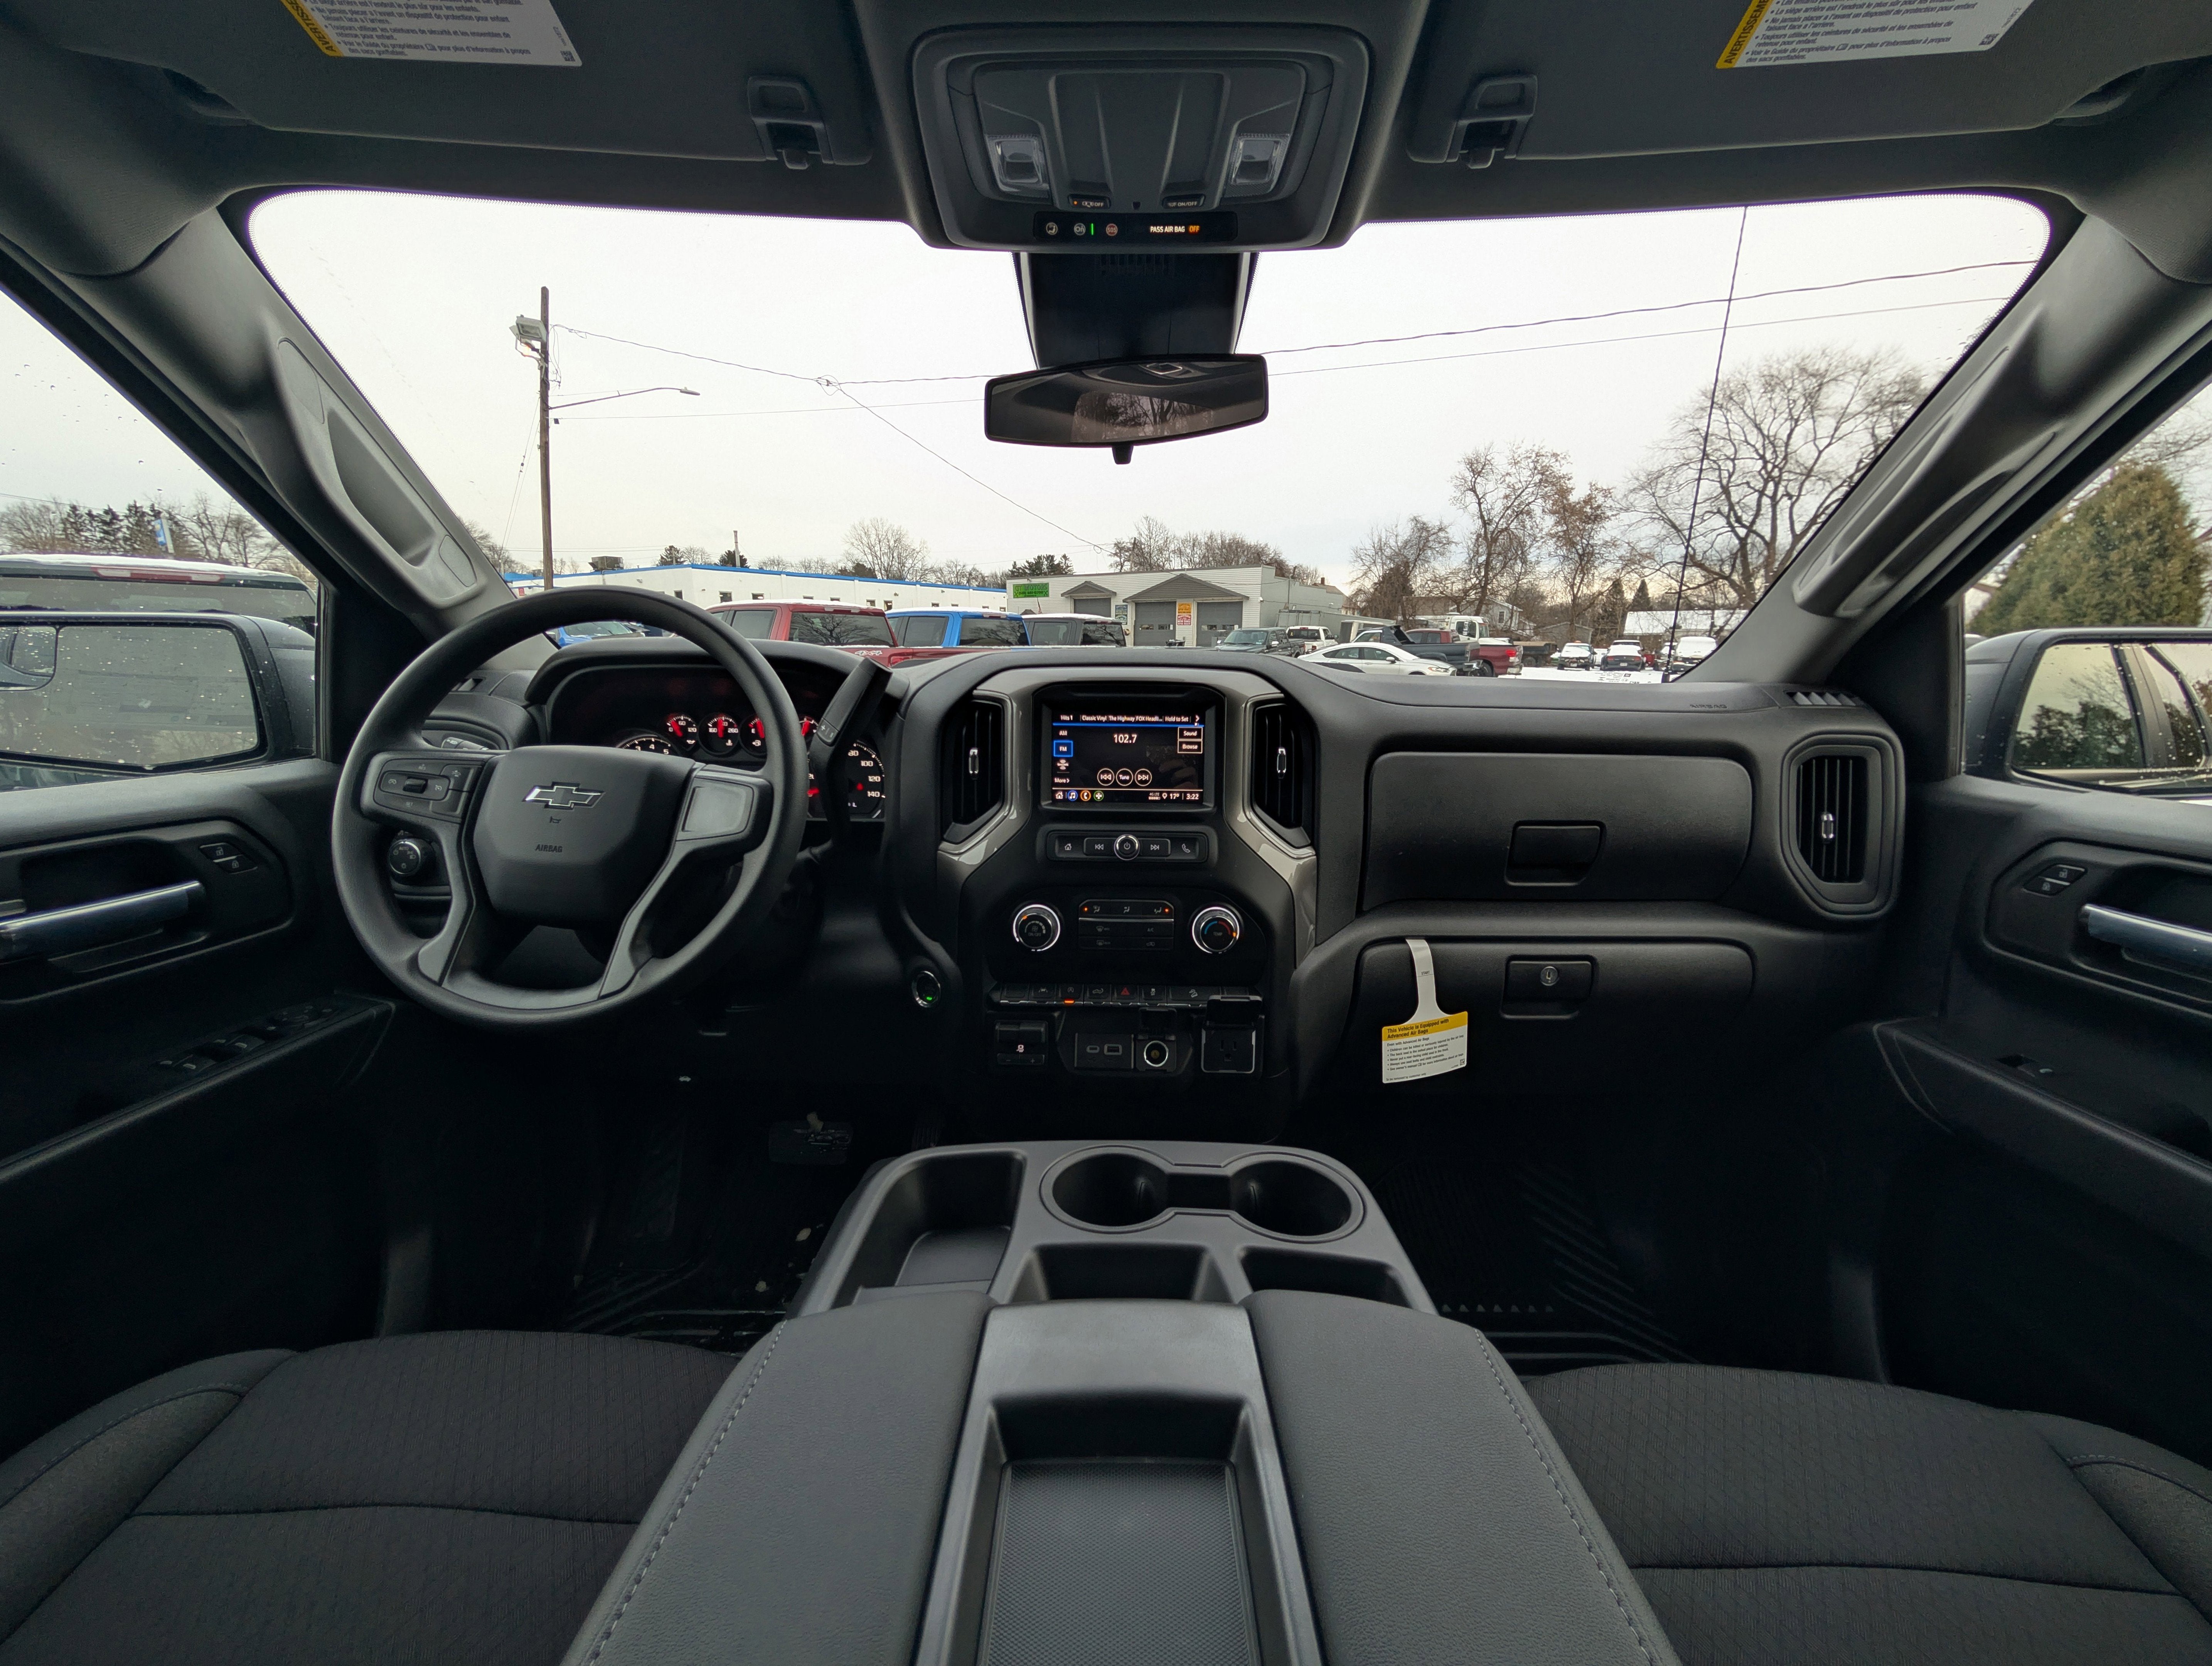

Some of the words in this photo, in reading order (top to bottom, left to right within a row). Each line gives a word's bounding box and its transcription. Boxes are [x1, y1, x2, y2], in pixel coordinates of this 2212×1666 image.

[1114, 734, 1137, 743] 102.7
[535, 844, 563, 853] AIRBAG
[1420, 1020, 1439, 1029] Equipped
